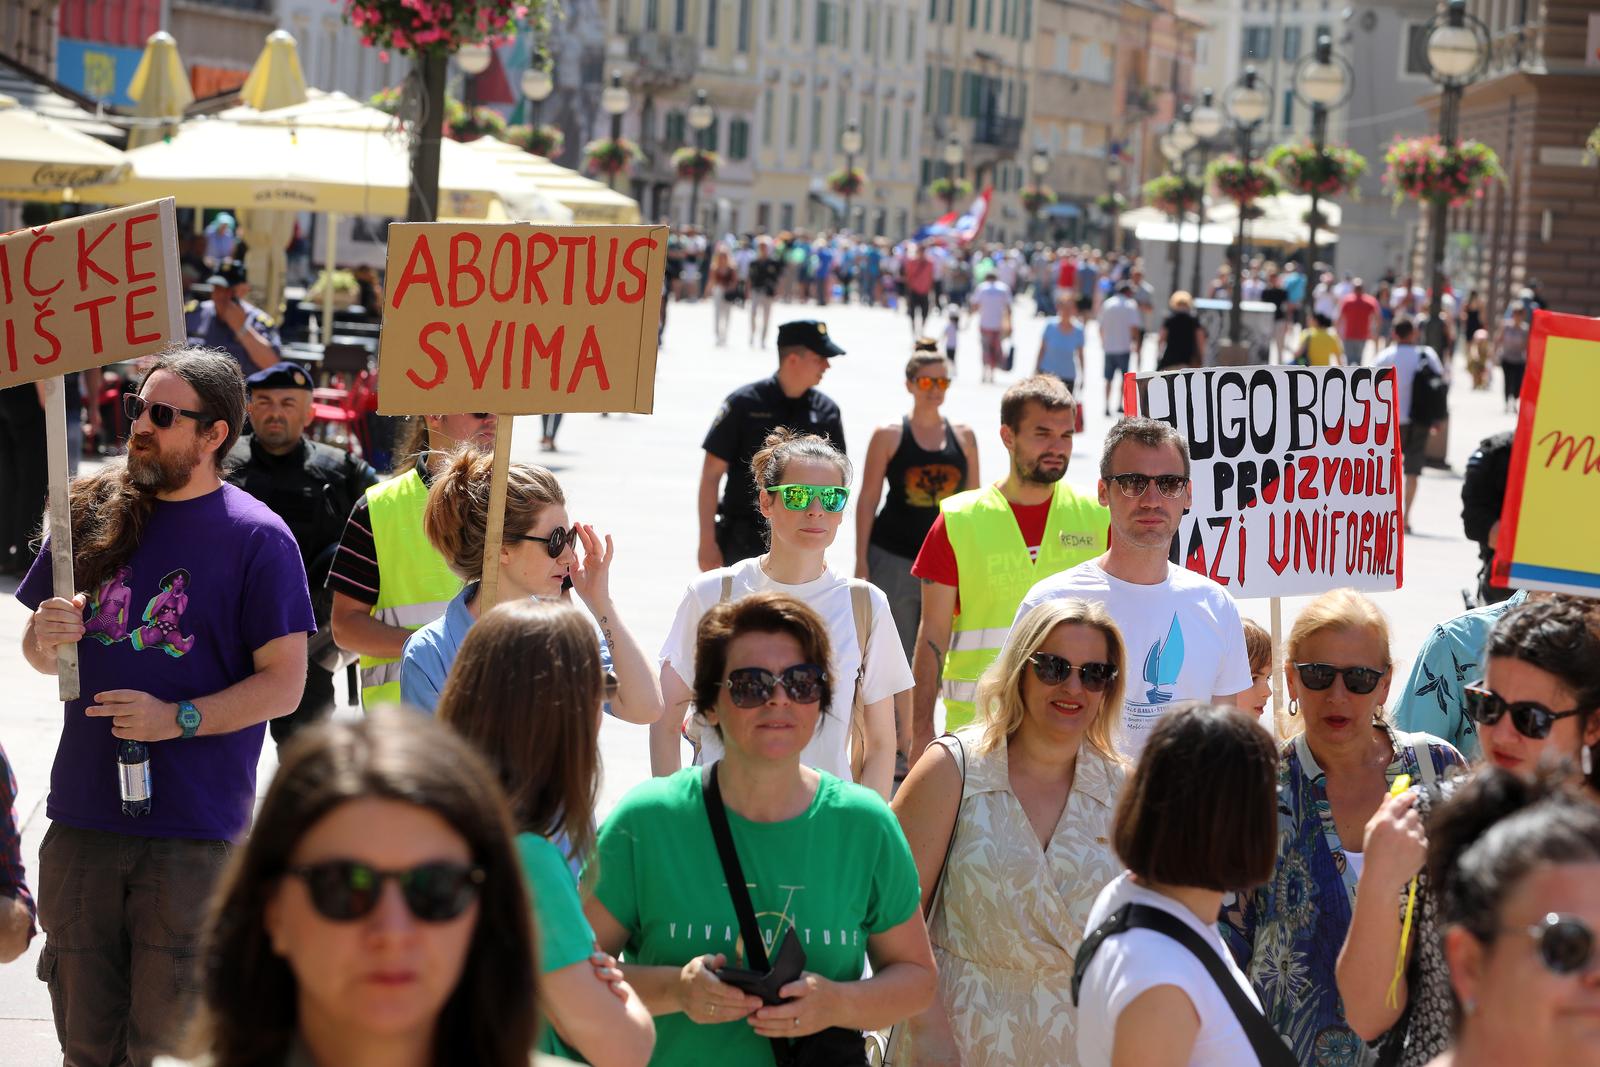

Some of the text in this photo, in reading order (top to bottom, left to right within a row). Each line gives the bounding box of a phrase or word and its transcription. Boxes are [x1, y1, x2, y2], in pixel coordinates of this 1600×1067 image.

[391, 231, 658, 309] ABORTUS
[0, 285, 161, 373] IŠTE
[406, 320, 610, 393] SVIMA
[1131, 367, 1394, 460] HUGO BOSS
[669, 922, 860, 947] VIVA OTURE
